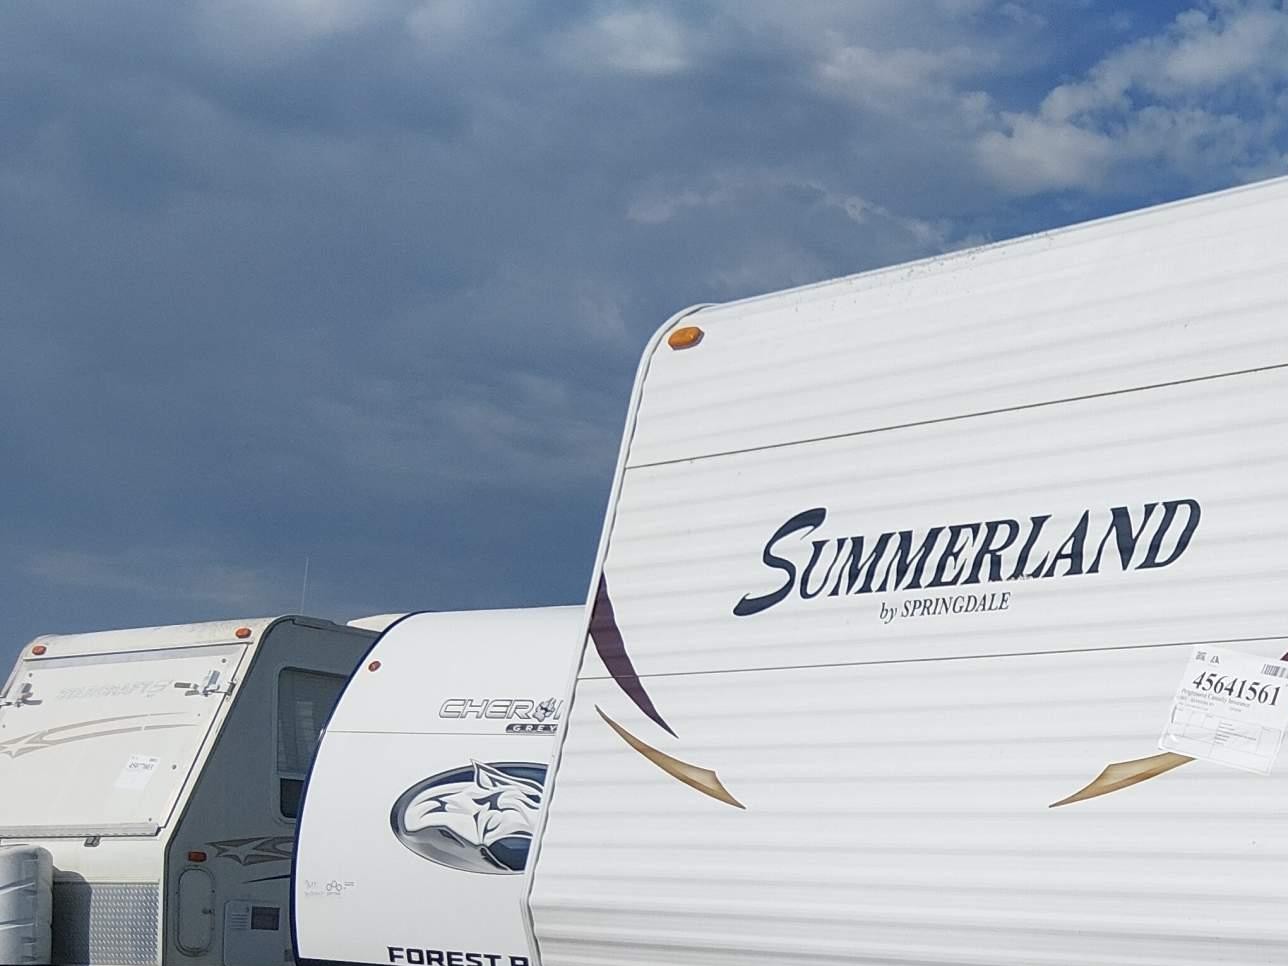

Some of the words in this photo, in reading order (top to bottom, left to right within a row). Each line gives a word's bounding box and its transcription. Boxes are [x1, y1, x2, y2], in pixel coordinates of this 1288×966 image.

[879, 602, 898, 624] by
[900, 592, 1011, 618] SPRINGDALE
[1192, 671, 1281, 706] 45641561
